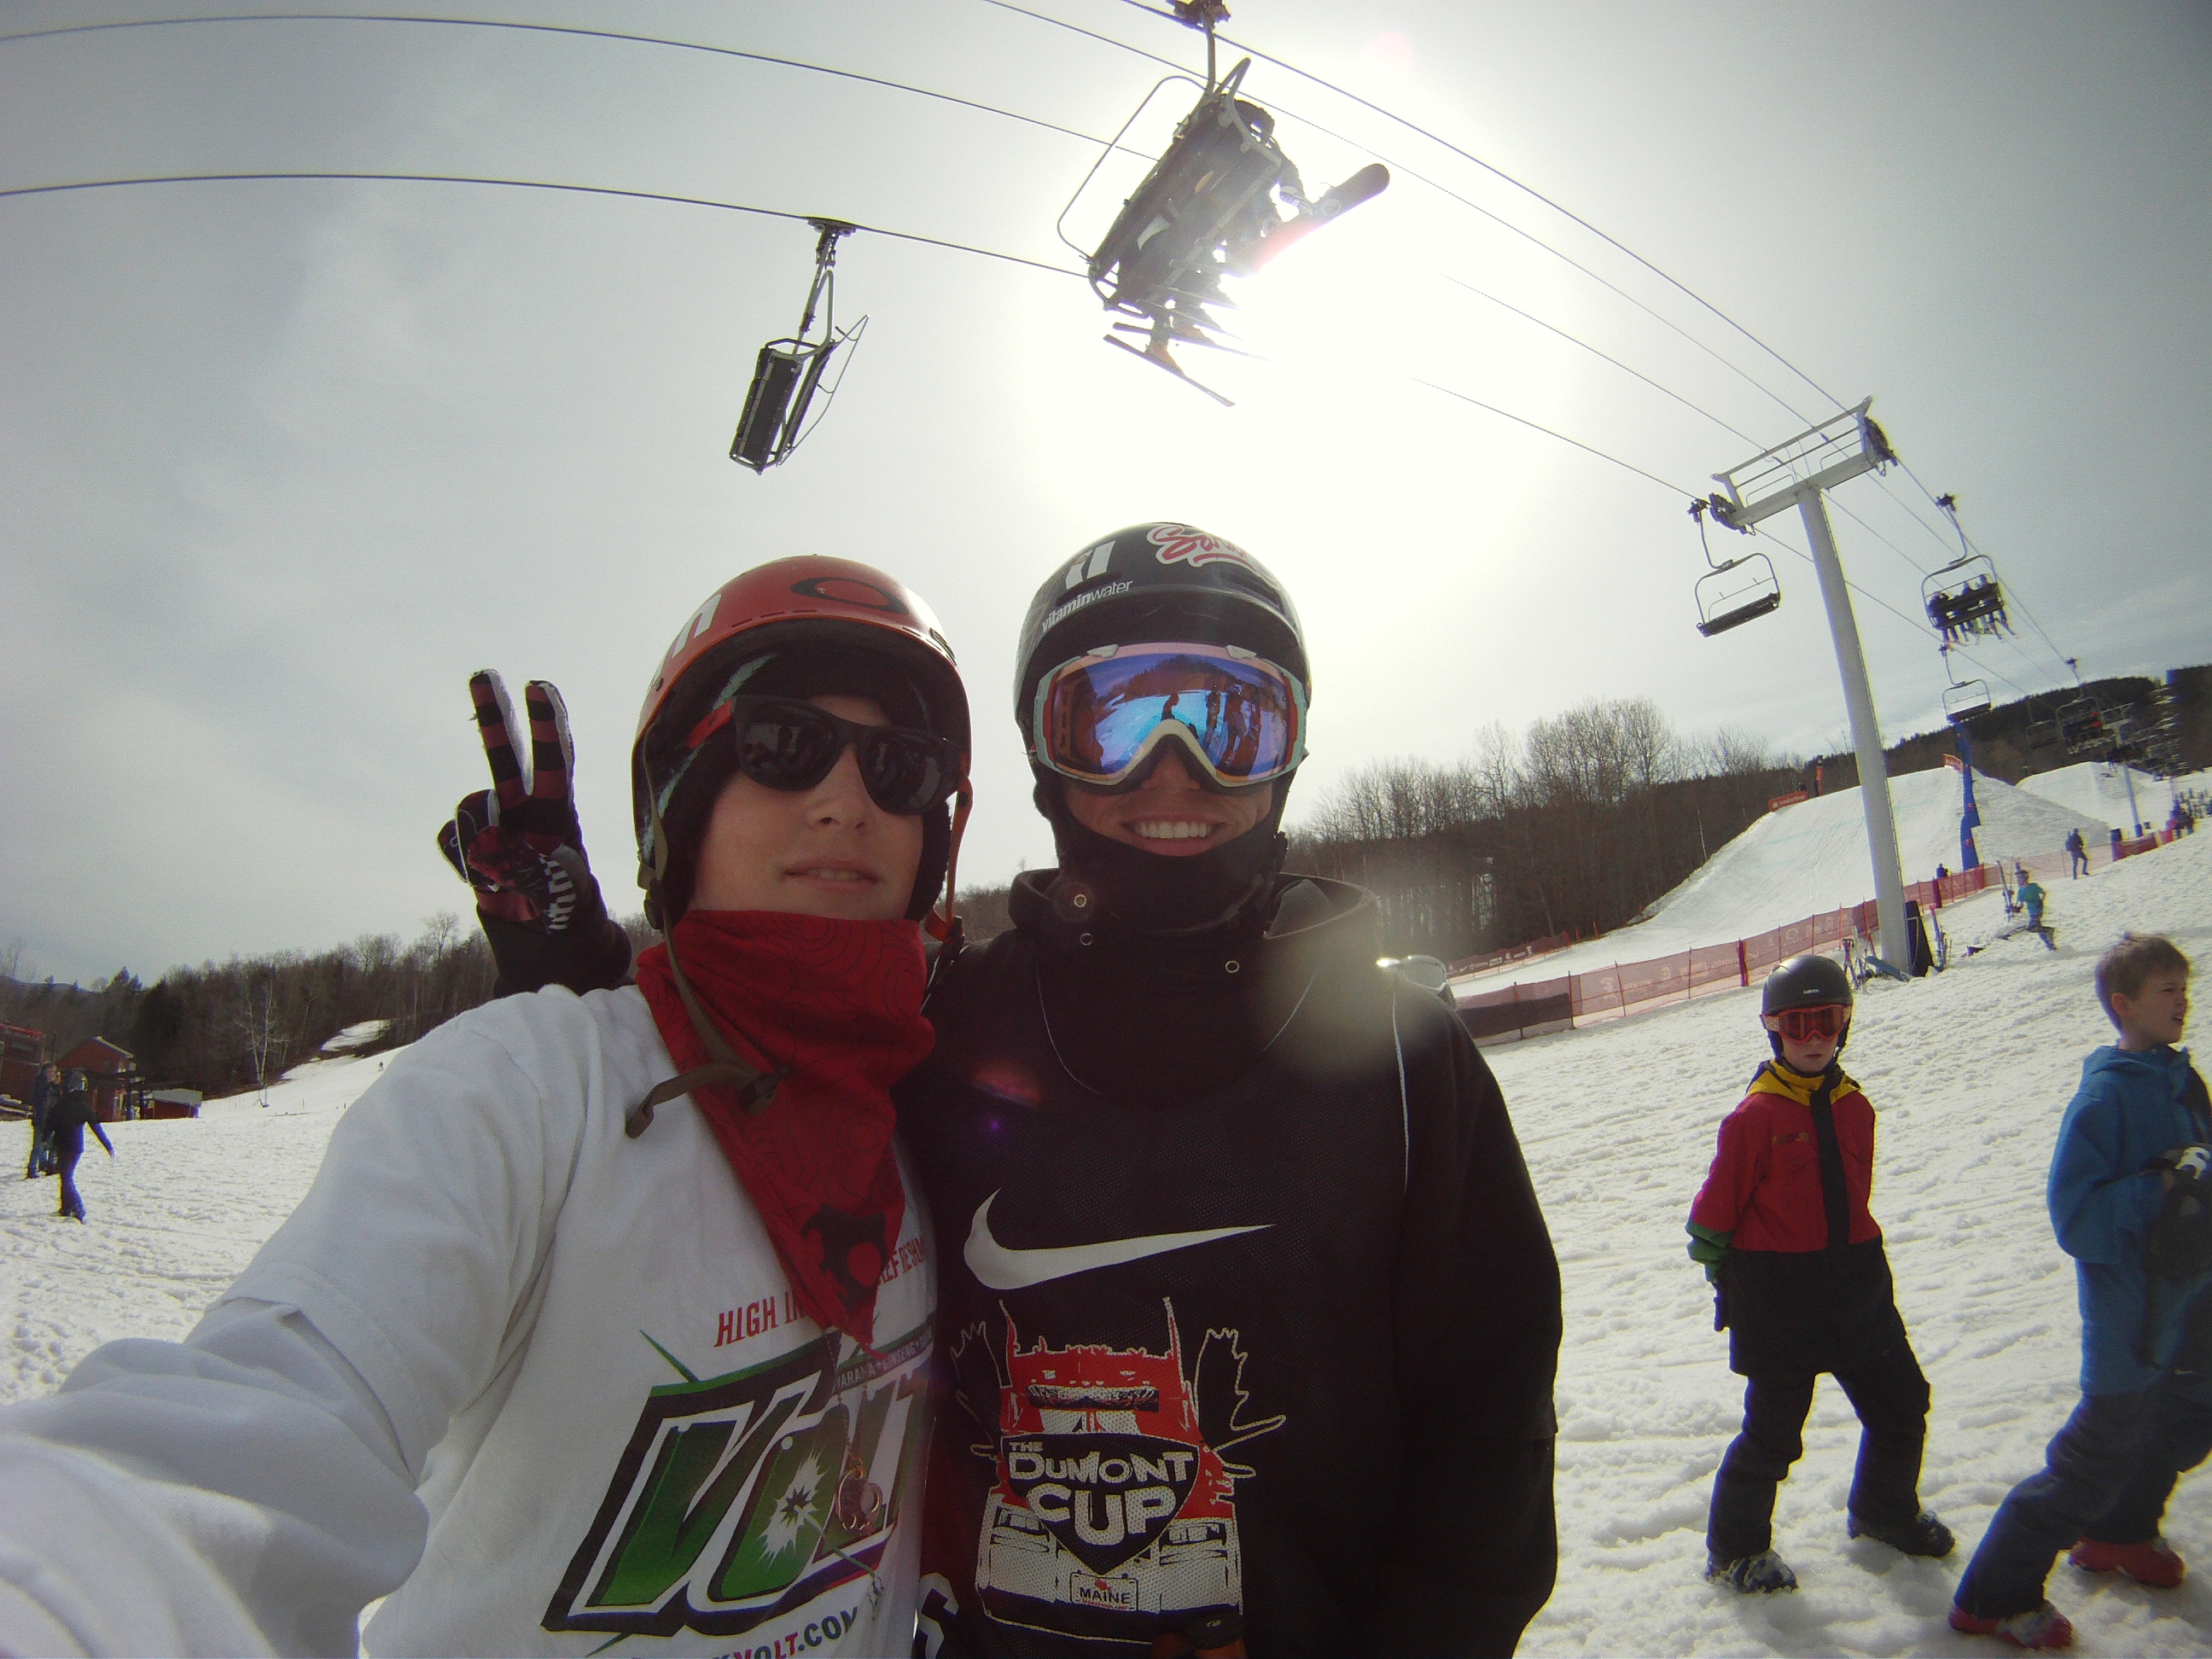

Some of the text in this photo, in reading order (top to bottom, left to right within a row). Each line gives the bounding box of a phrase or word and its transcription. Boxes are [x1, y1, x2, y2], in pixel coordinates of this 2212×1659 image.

[1041, 580, 1134, 633] vitaminwater
[713, 1295, 779, 1348] HIGH
[1009, 1441, 1044, 1452] THE
[1009, 1450, 1195, 1484] DUMONT
[1026, 1481, 1177, 1546] CUP
[1080, 1586, 1131, 1604] MAINE
